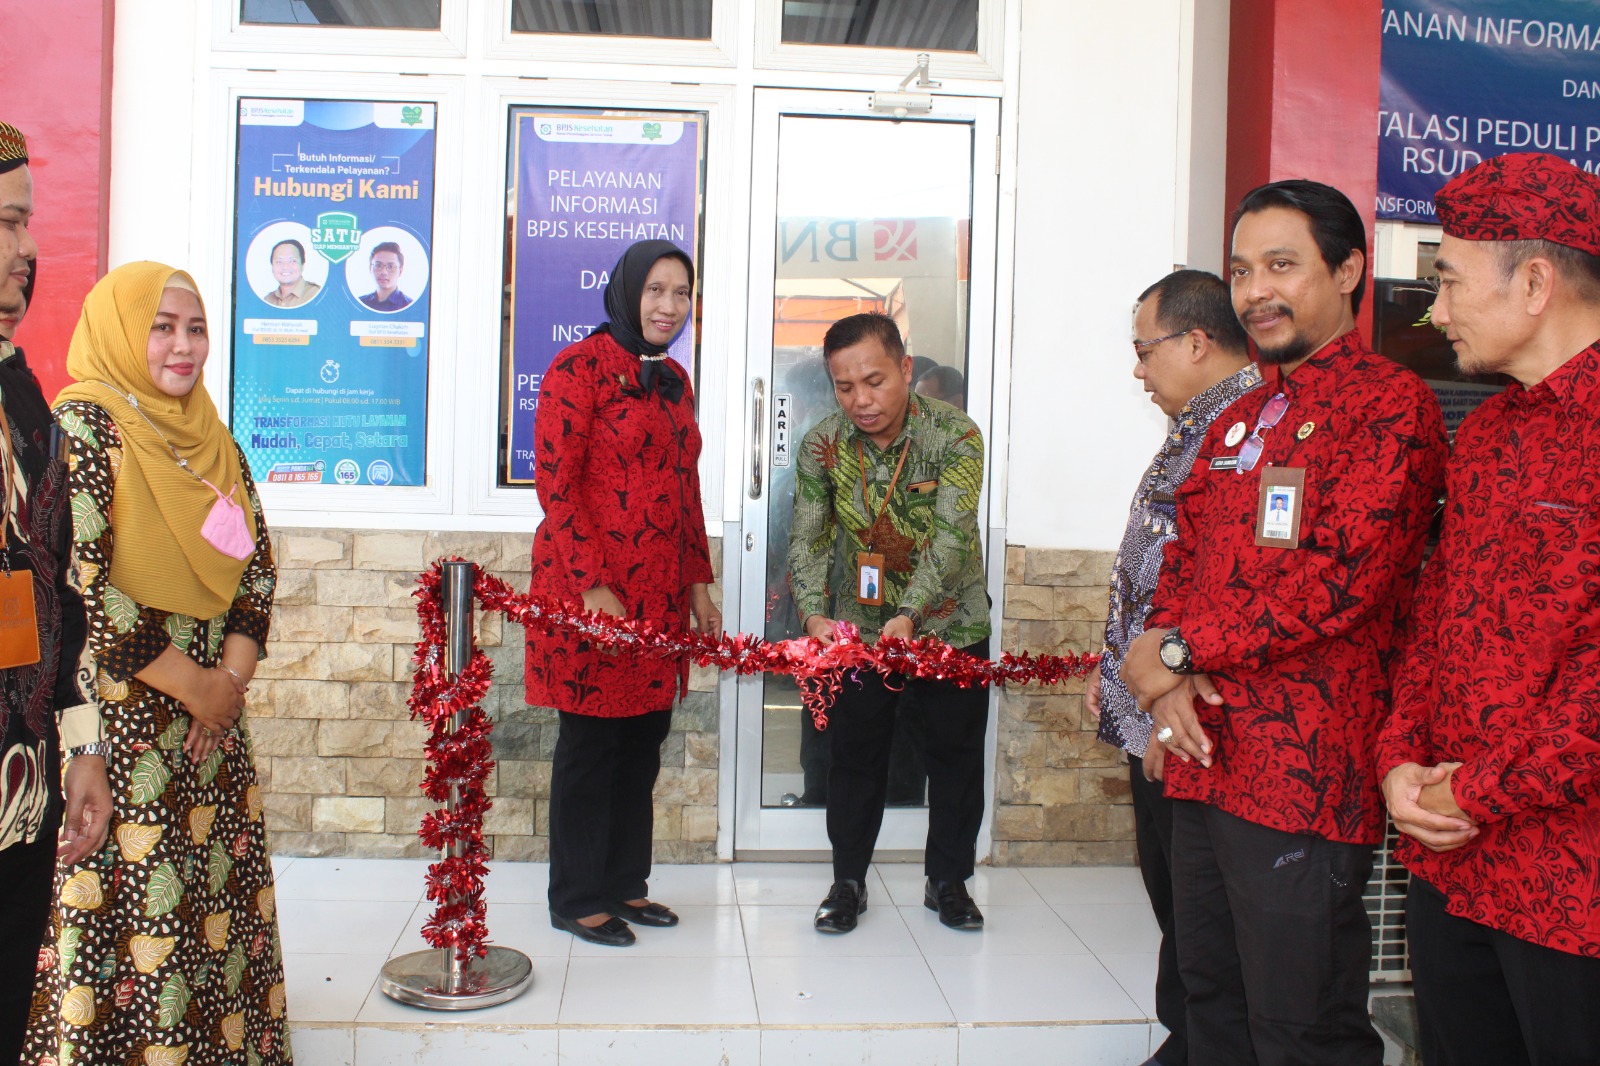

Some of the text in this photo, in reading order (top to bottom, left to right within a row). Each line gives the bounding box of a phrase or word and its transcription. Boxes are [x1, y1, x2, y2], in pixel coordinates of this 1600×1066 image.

[1381, 9, 1466, 42] ANAN
[556, 124, 613, 133] BPJS Kesehatan
[1477, 118, 1576, 150] PEDULI
[300, 153, 376, 163] Butuh Informasi/
[1402, 147, 1482, 176] RSUD
[284, 164, 390, 176] Terkendala Pelayanan?
[548, 170, 661, 189] PELAYANAN
[254, 176, 419, 202] Hubungi Kami
[550, 195, 657, 214] INFORMASI
[311, 228, 362, 244] SATU
[527, 220, 684, 240] BPJS KESEHATAN
[359, 388, 374, 396] kerja
[518, 374, 544, 391] PE
[254, 415, 406, 428] TRANSFORMASI MUTU LAYANAN
[777, 398, 787, 452] TARIK
[251, 432, 408, 452] Mudah, Cepat, Setara
